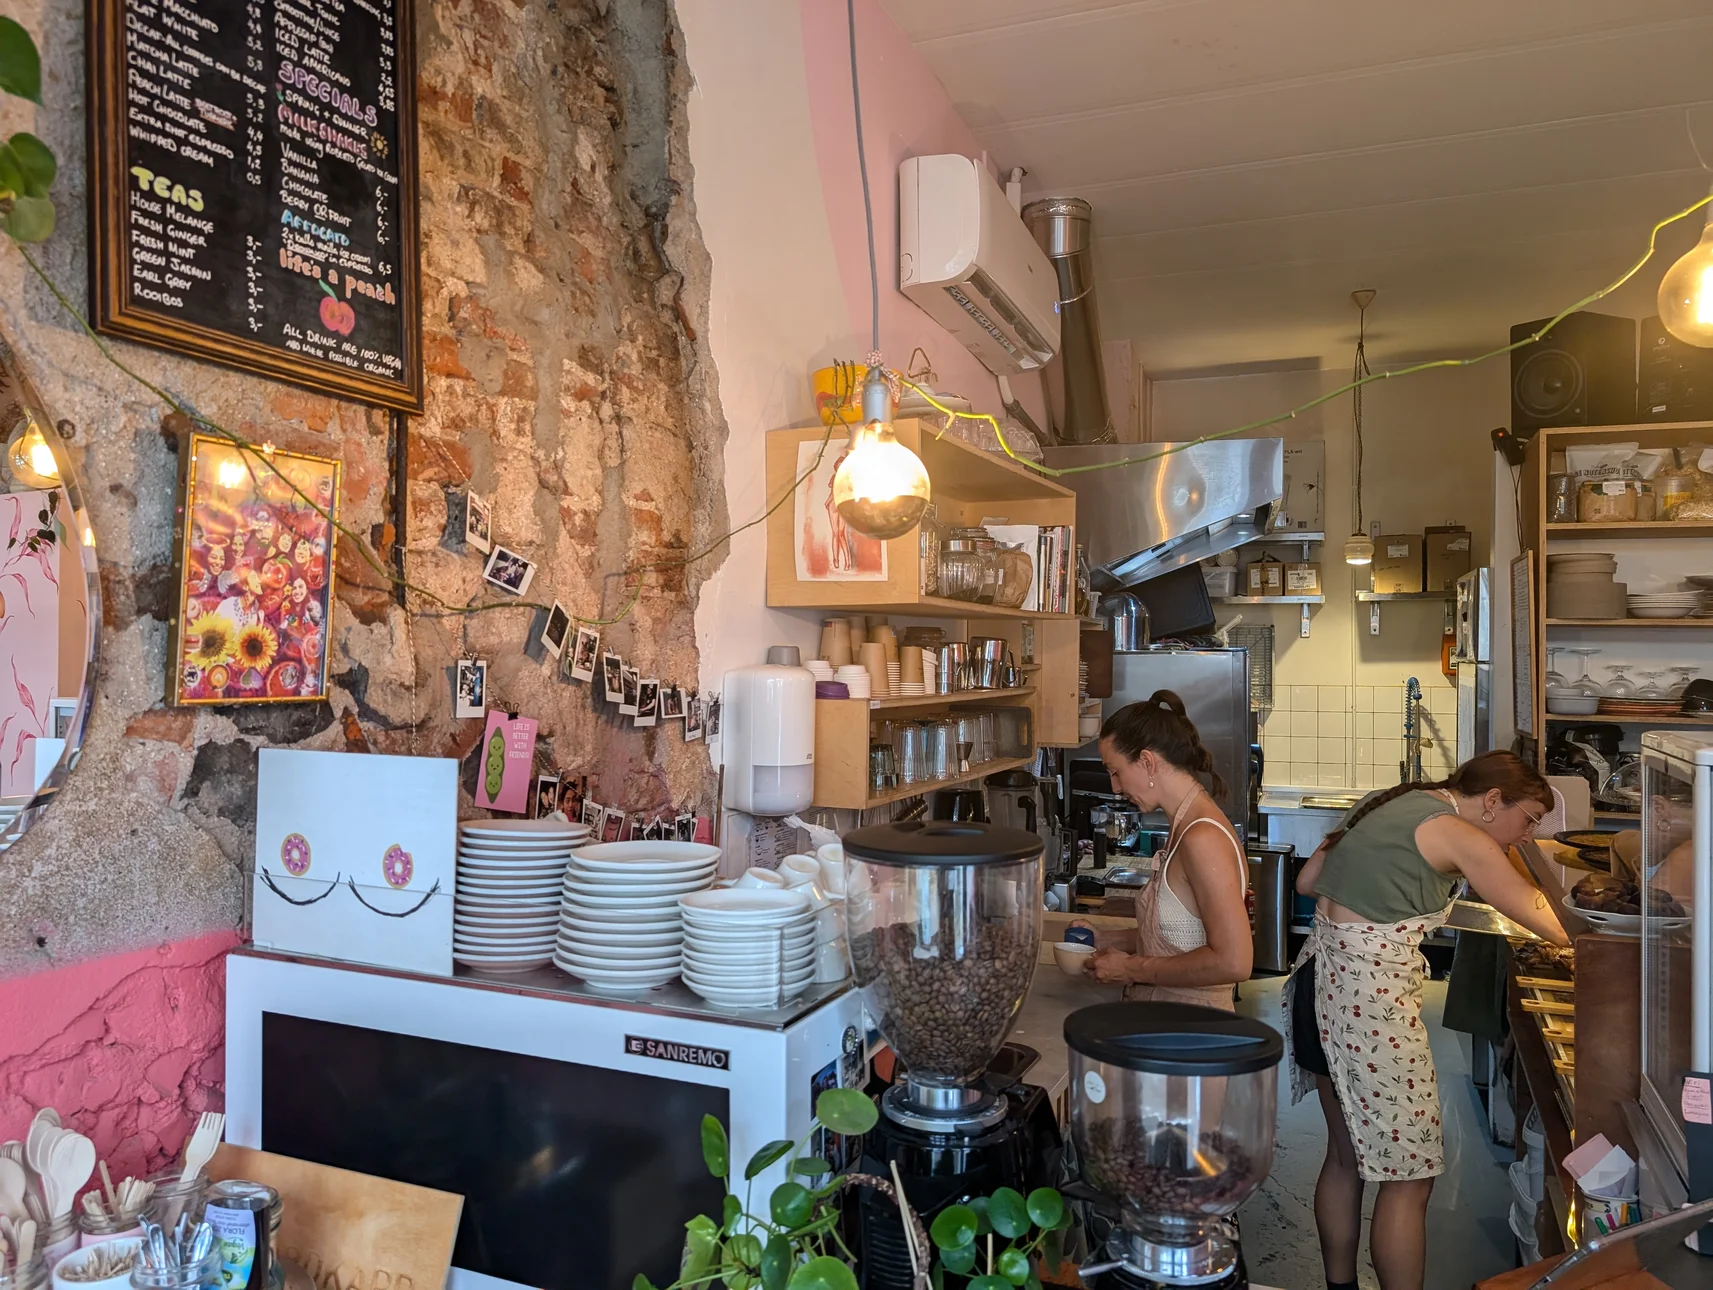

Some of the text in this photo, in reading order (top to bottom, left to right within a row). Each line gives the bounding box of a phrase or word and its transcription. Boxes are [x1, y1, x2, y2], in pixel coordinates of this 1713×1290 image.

[162, 12, 199, 41] WHITE
[275, 27, 331, 65] ICED LATTE
[276, 43, 298, 61] ICED
[127, 51, 191, 89] CHAI LATTE
[171, 52, 200, 77] LATTE
[128, 68, 161, 96] PEACH
[162, 84, 191, 110] LATTE
[278, 60, 377, 127] SPECIALS
[128, 87, 207, 133] HOT CHOCOLATE
[285, 89, 320, 117] SPRING
[332, 114, 369, 139] SUMMER
[129, 106, 234, 159] EXTRA SHOT ESPRESSO
[129, 124, 214, 168] WHIPPED CREAM
[305, 137, 324, 158] using
[247, 156, 262, 170] 1,2
[280, 141, 318, 170] VANILLA
[280, 158, 319, 184] BANANA
[130, 166, 205, 212] TEAS
[281, 176, 329, 203] CHOCOLATE
[130, 190, 214, 234] HOUSE MELANGE
[279, 190, 352, 228] BERRY OR FRUIT
[130, 210, 207, 247] FRESH GINGER
[131, 229, 196, 259] FRESH MINT
[281, 209, 351, 247] AFFOGATO
[132, 247, 212, 281] GREEN JASMIN
[133, 264, 192, 290] EARL GREY
[279, 247, 396, 305] life's a peach
[378, 261, 392, 276] 6,5
[133, 282, 184, 307] ROOIBOS
[283, 323, 303, 339] ALL
[342, 342, 358, 355] ARE
[382, 354, 402, 370] VEGAN
[329, 351, 359, 367] POSSIBLE
[364, 362, 395, 378] ORGANIC
[512, 732, 529, 740] BETTER
[513, 741, 528, 749] WITH
[646, 1041, 726, 1067] SANREMO
